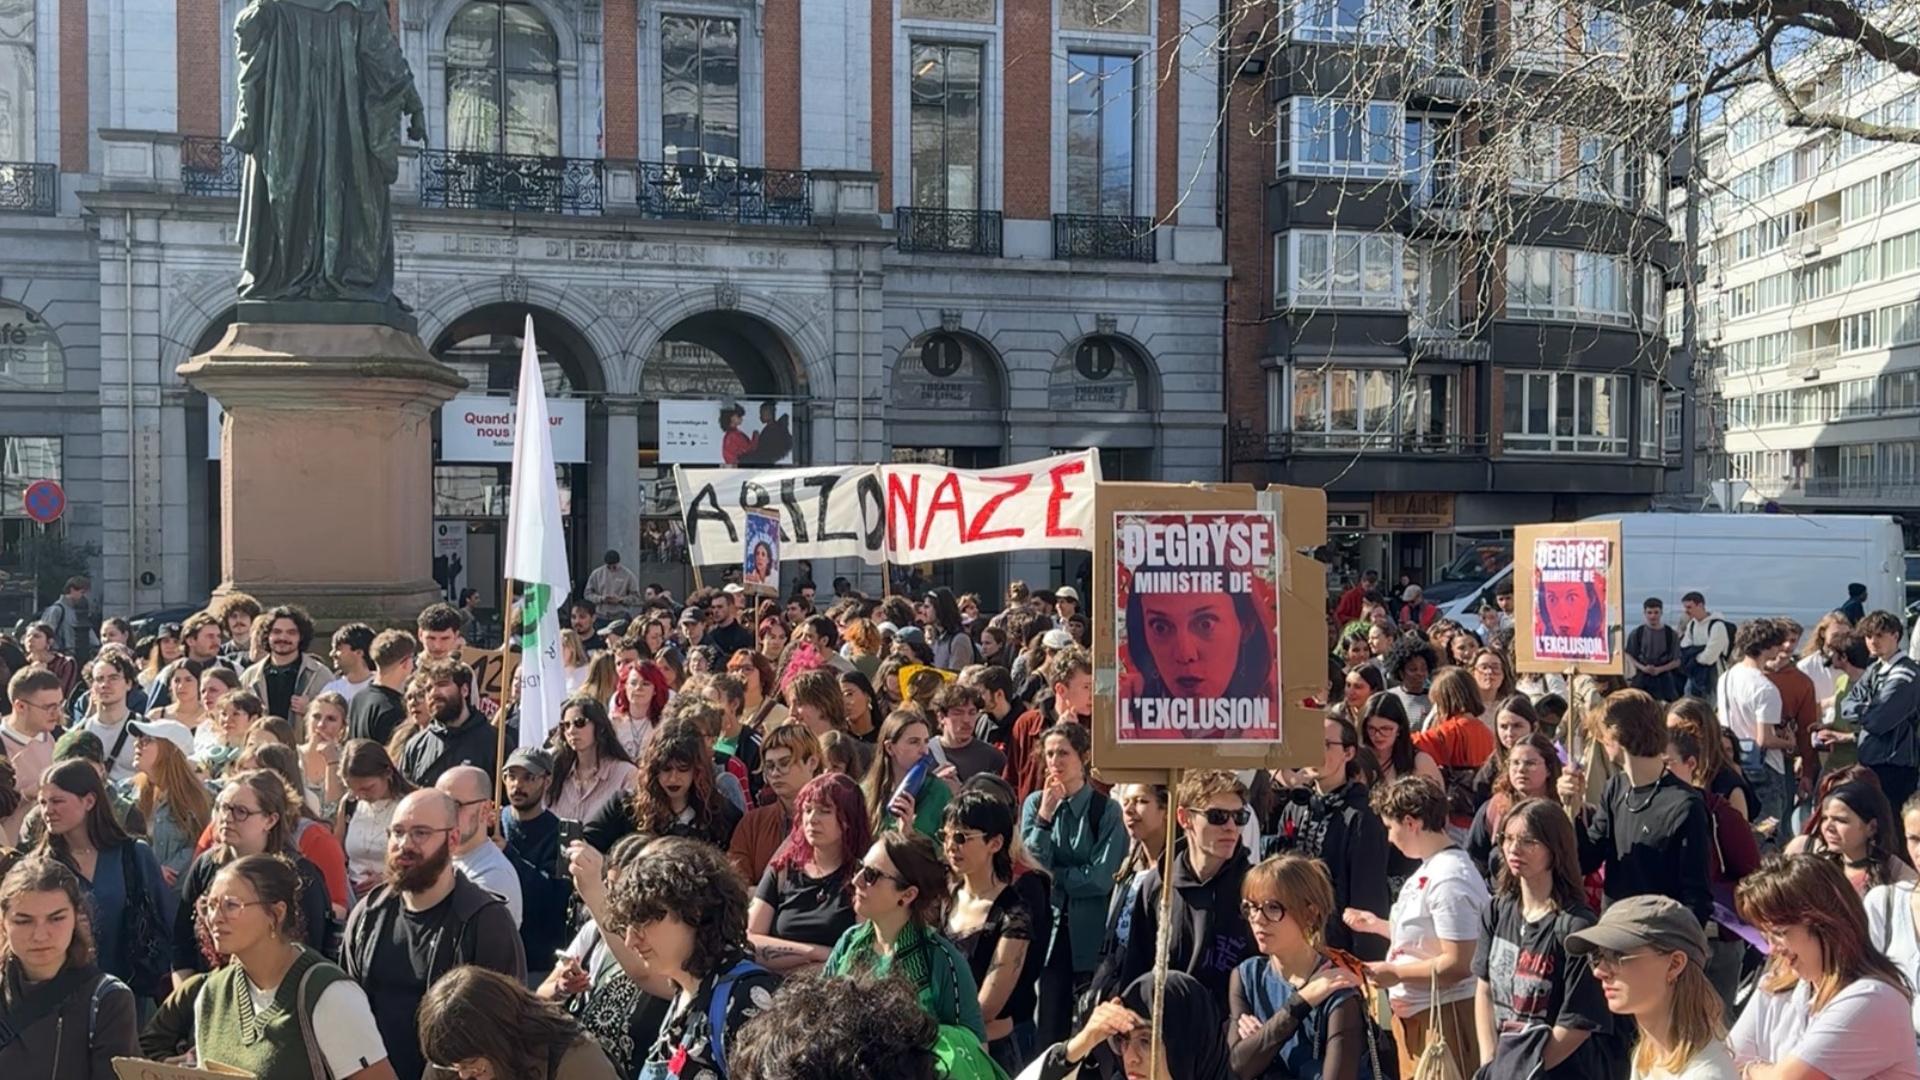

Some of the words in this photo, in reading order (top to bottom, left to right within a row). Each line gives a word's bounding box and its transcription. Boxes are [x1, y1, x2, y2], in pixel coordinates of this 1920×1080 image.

[444, 235, 519, 256] LIBRE
[0, 322, 26, 345] fé
[464, 412, 510, 425] Quand
[477, 427, 510, 438] nous
[1123, 522, 1269, 567] DEGRYSE
[1537, 543, 1605, 569] DEGRYSE
[1135, 571, 1223, 593] MINISTRE
[1230, 571, 1252, 593] DE
[1542, 570, 1581, 583] MINISTRE
[1583, 570, 1595, 583] DE
[1121, 697, 1277, 730] L'EXCLUSION.
